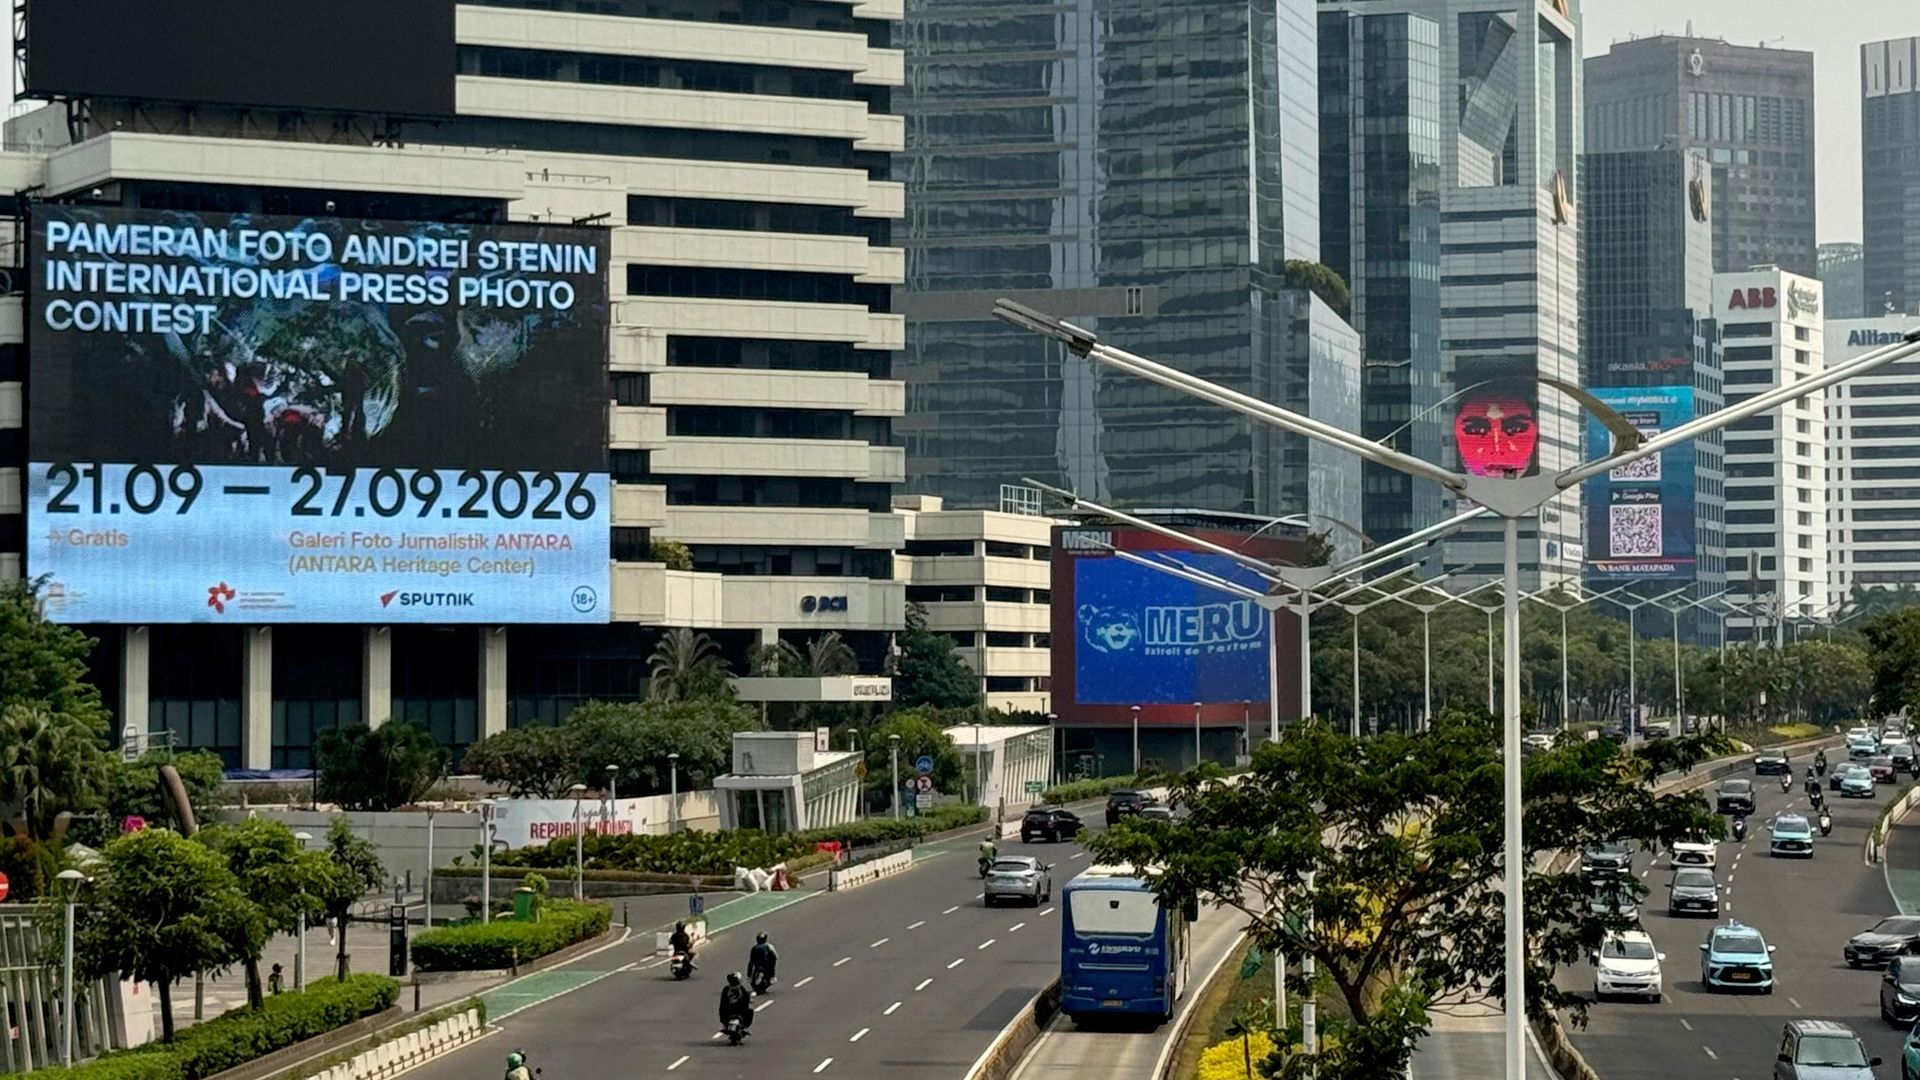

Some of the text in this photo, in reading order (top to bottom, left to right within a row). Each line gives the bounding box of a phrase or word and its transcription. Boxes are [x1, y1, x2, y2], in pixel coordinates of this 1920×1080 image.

[45, 220, 598, 275] PAMERAN FOTO ANDREI STENIN
[45, 260, 575, 310] INTERNATIONAL PRESS PHOTO
[1728, 287, 1777, 310] ABB
[45, 300, 217, 334] CONTEST
[1848, 329, 1905, 347] Allian
[45, 463, 203, 515] 21.09
[290, 467, 598, 521] 27.09.2026
[68, 528, 130, 547] Gratis
[289, 531, 573, 550] Galeri Foto Jurnalistik ANTARA
[1062, 531, 1112, 549] MERU
[288, 555, 536, 578] (ANTARA Heritage Center)
[400, 592, 595, 606] SPUTNIK 18+
[1145, 601, 1264, 645] MERU
